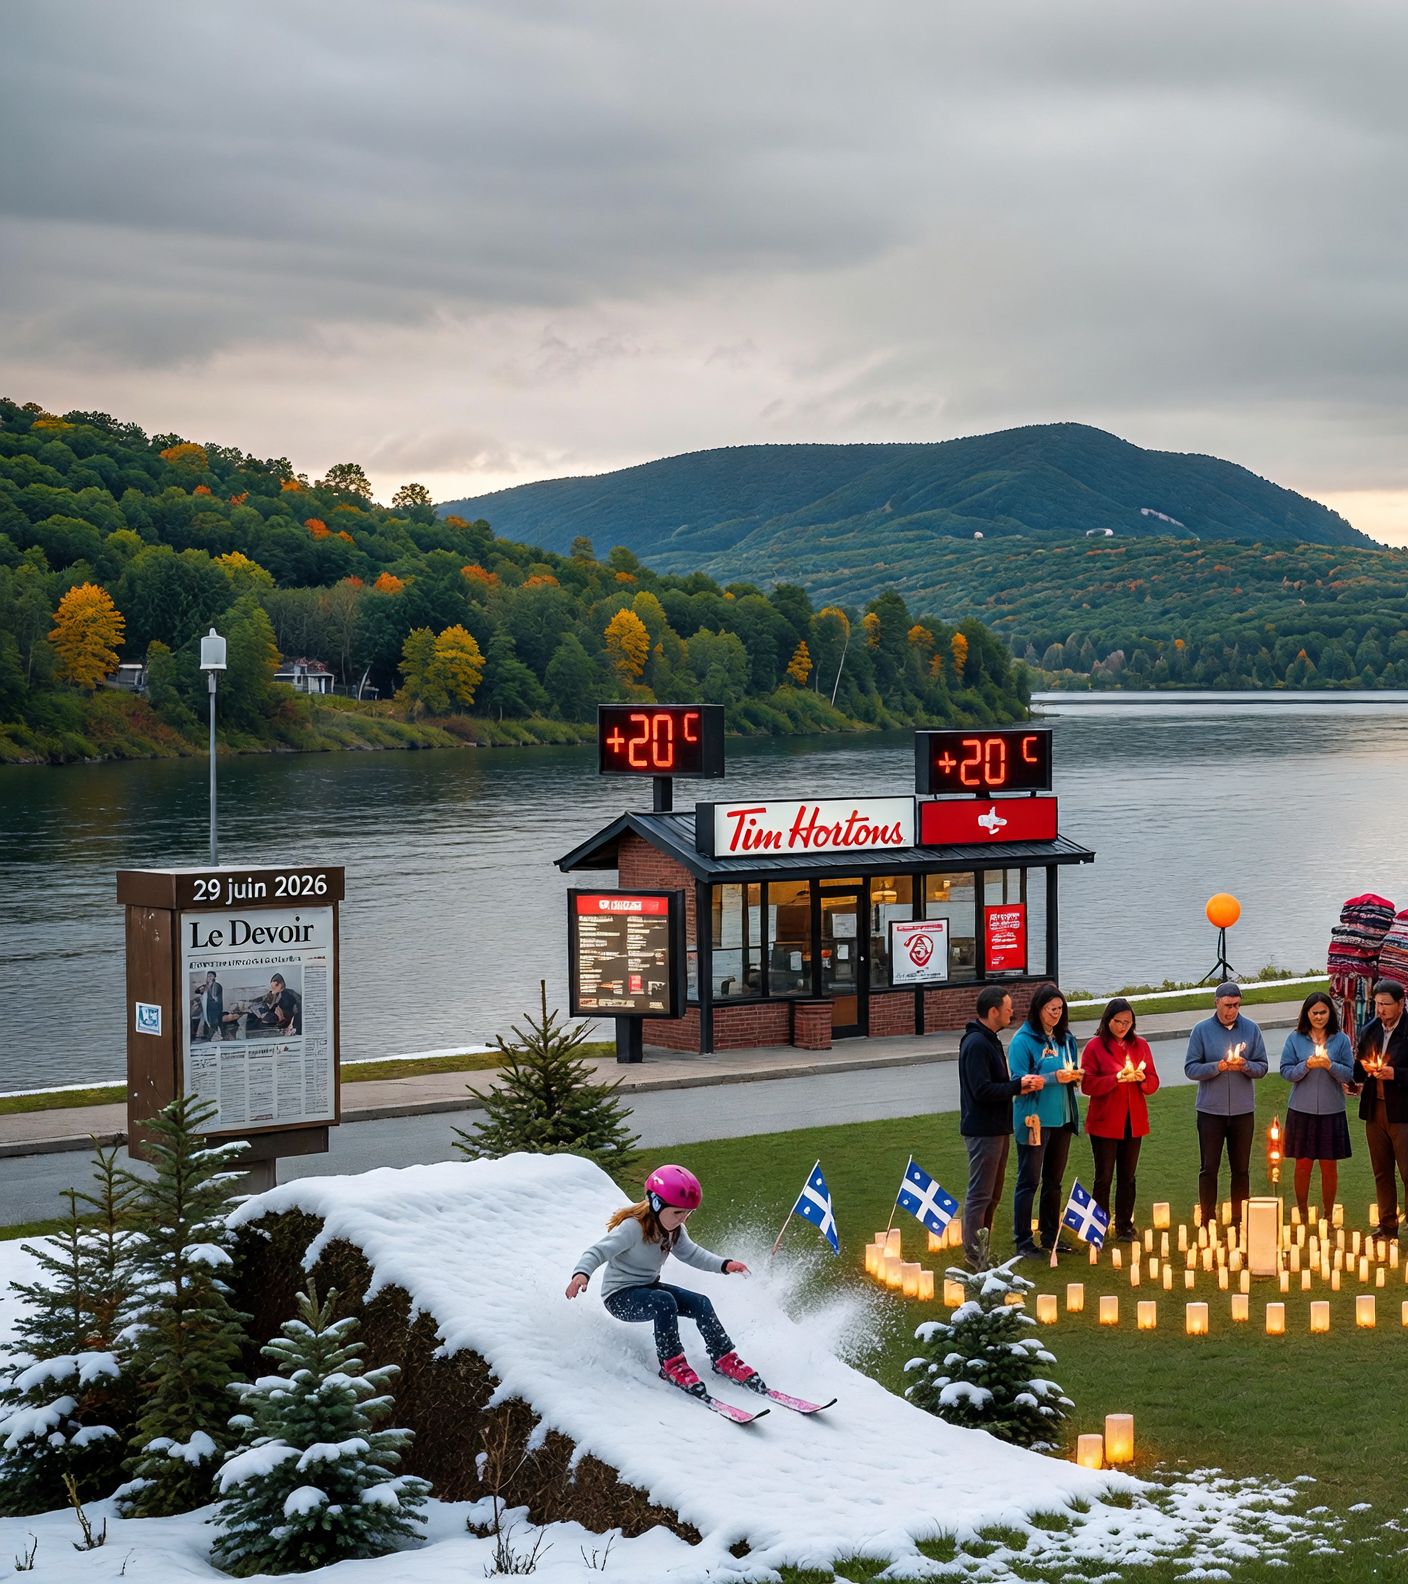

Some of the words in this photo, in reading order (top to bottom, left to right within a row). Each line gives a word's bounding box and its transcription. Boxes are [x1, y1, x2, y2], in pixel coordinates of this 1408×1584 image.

[606, 714, 673, 768] +20
[938, 738, 1006, 786] +20
[727, 807, 783, 852] Tim
[788, 805, 905, 849] Hortons
[193, 879, 221, 901] 29
[225, 877, 267, 905] juin
[274, 874, 328, 897] 2026
[189, 921, 224, 948] Le
[228, 915, 315, 946] Devoir
